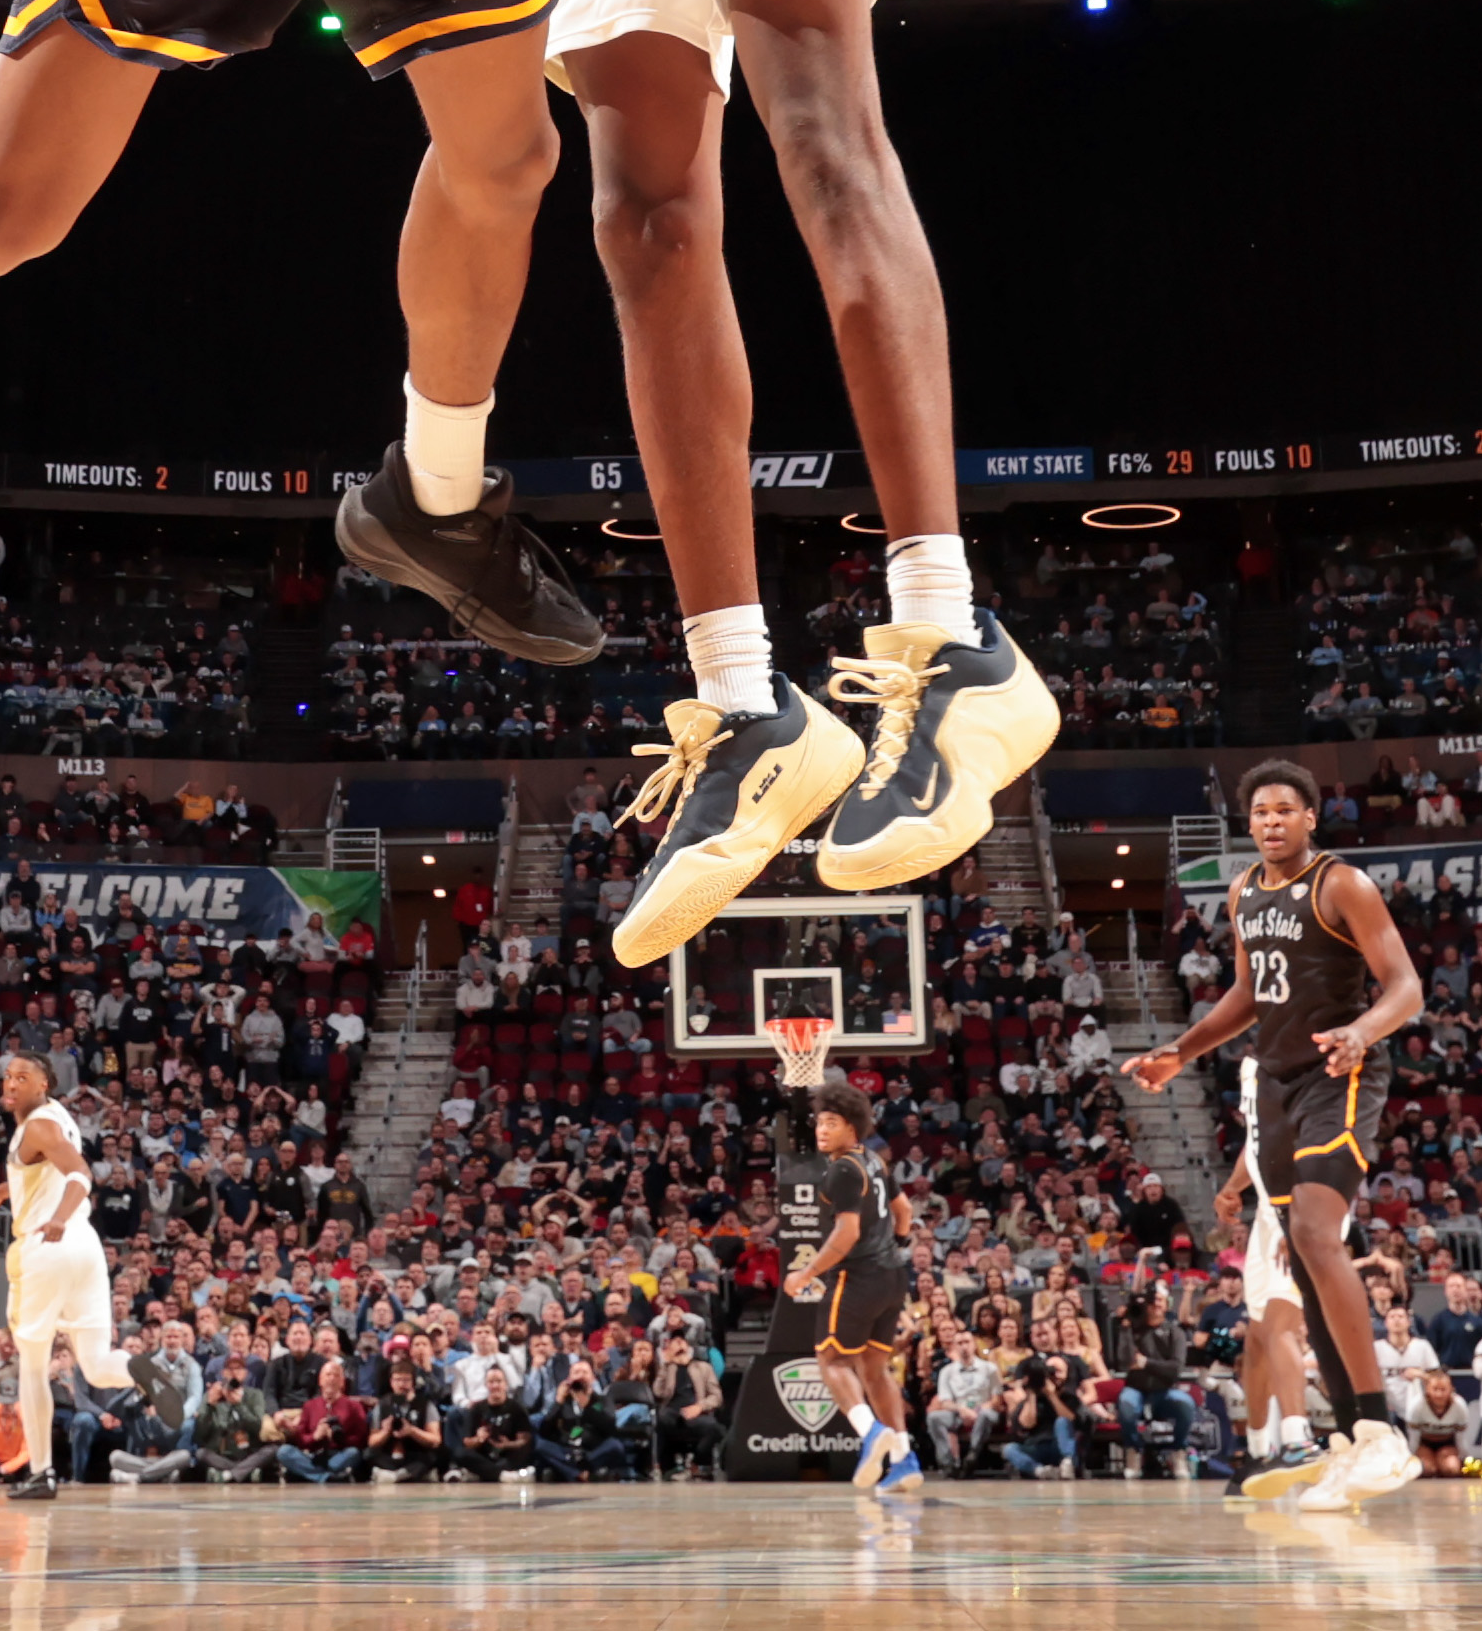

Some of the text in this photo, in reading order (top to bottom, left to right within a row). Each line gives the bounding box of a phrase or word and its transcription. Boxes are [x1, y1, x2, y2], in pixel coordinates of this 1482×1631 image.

[1215, 443, 1312, 472] FOULS 10
[1359, 434, 1461, 463] TIMEOUTS:
[44, 462, 168, 490] TIMEOUTS: 2
[985, 453, 1084, 477] KENT STATE
[1108, 450, 1193, 475] FG% 29
[214, 470, 308, 494] FOULS 10
[590, 463, 622, 490] 65
[58, 758, 105, 776] M113
[1236, 907, 1303, 942] Kent State
[1250, 950, 1291, 1004] 23
[747, 1433, 808, 1452] Credit
